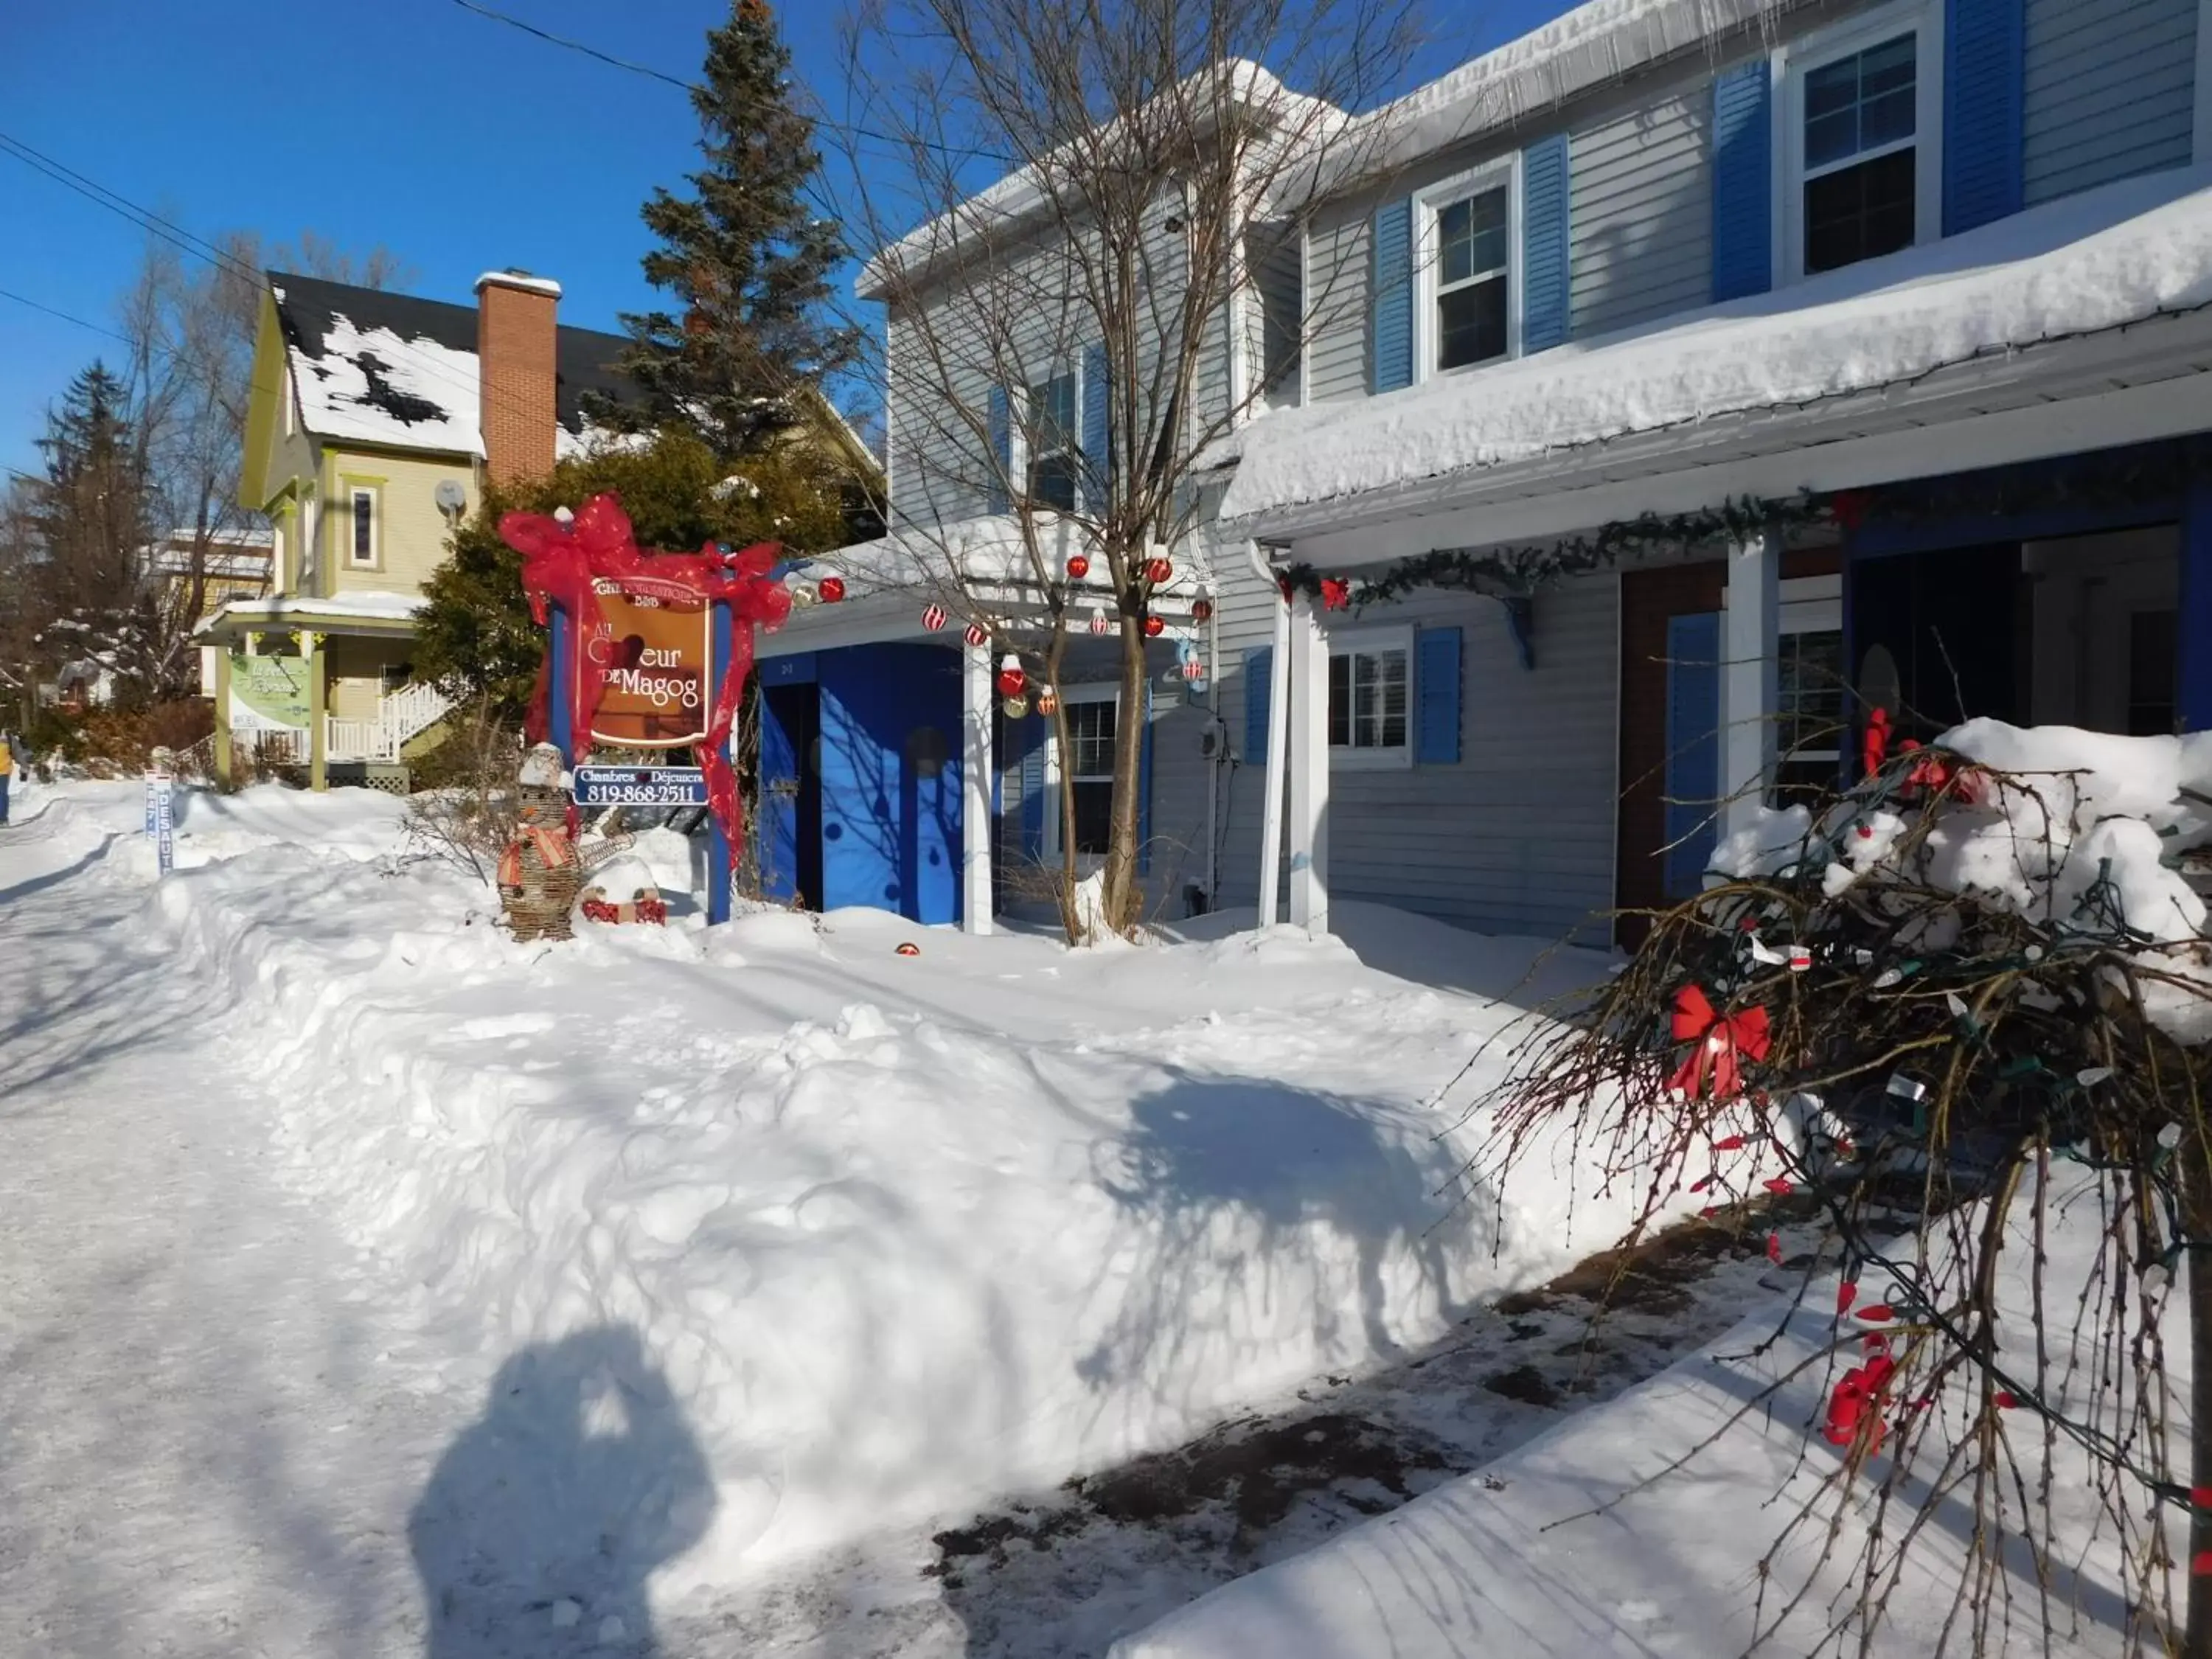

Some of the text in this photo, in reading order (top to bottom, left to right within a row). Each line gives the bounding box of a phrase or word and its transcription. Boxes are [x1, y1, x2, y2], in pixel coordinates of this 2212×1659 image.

[619, 668, 699, 709] Magog
[580, 769, 636, 783] Chambres
[587, 785, 695, 803] 819-868-2511
